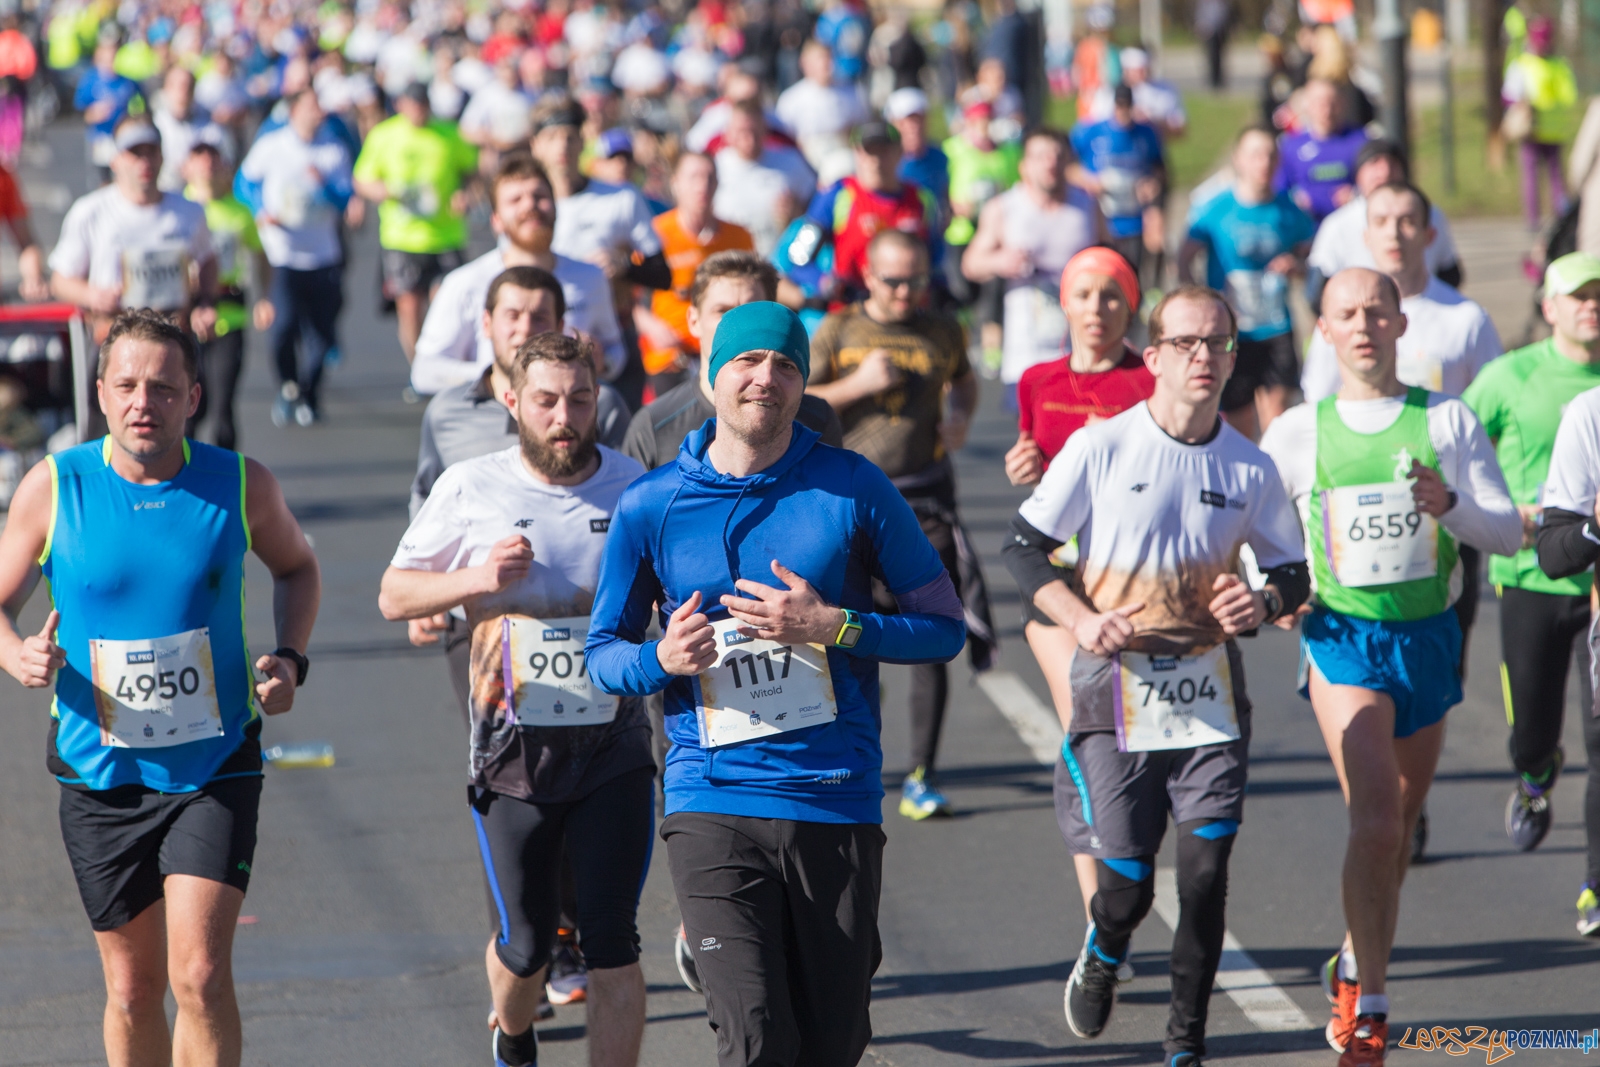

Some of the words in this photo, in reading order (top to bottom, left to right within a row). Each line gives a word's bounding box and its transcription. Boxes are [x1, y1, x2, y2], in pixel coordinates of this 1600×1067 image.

[1349, 511, 1421, 541] 6559
[726, 635, 736, 643] 10.
[128, 654, 138, 662] 10.
[138, 653, 153, 662] PKO
[725, 645, 792, 689] 1117
[116, 666, 199, 702] 4950
[750, 685, 783, 700] Witold
[1138, 675, 1217, 707] 7404
[150, 705, 172, 715] Lech
